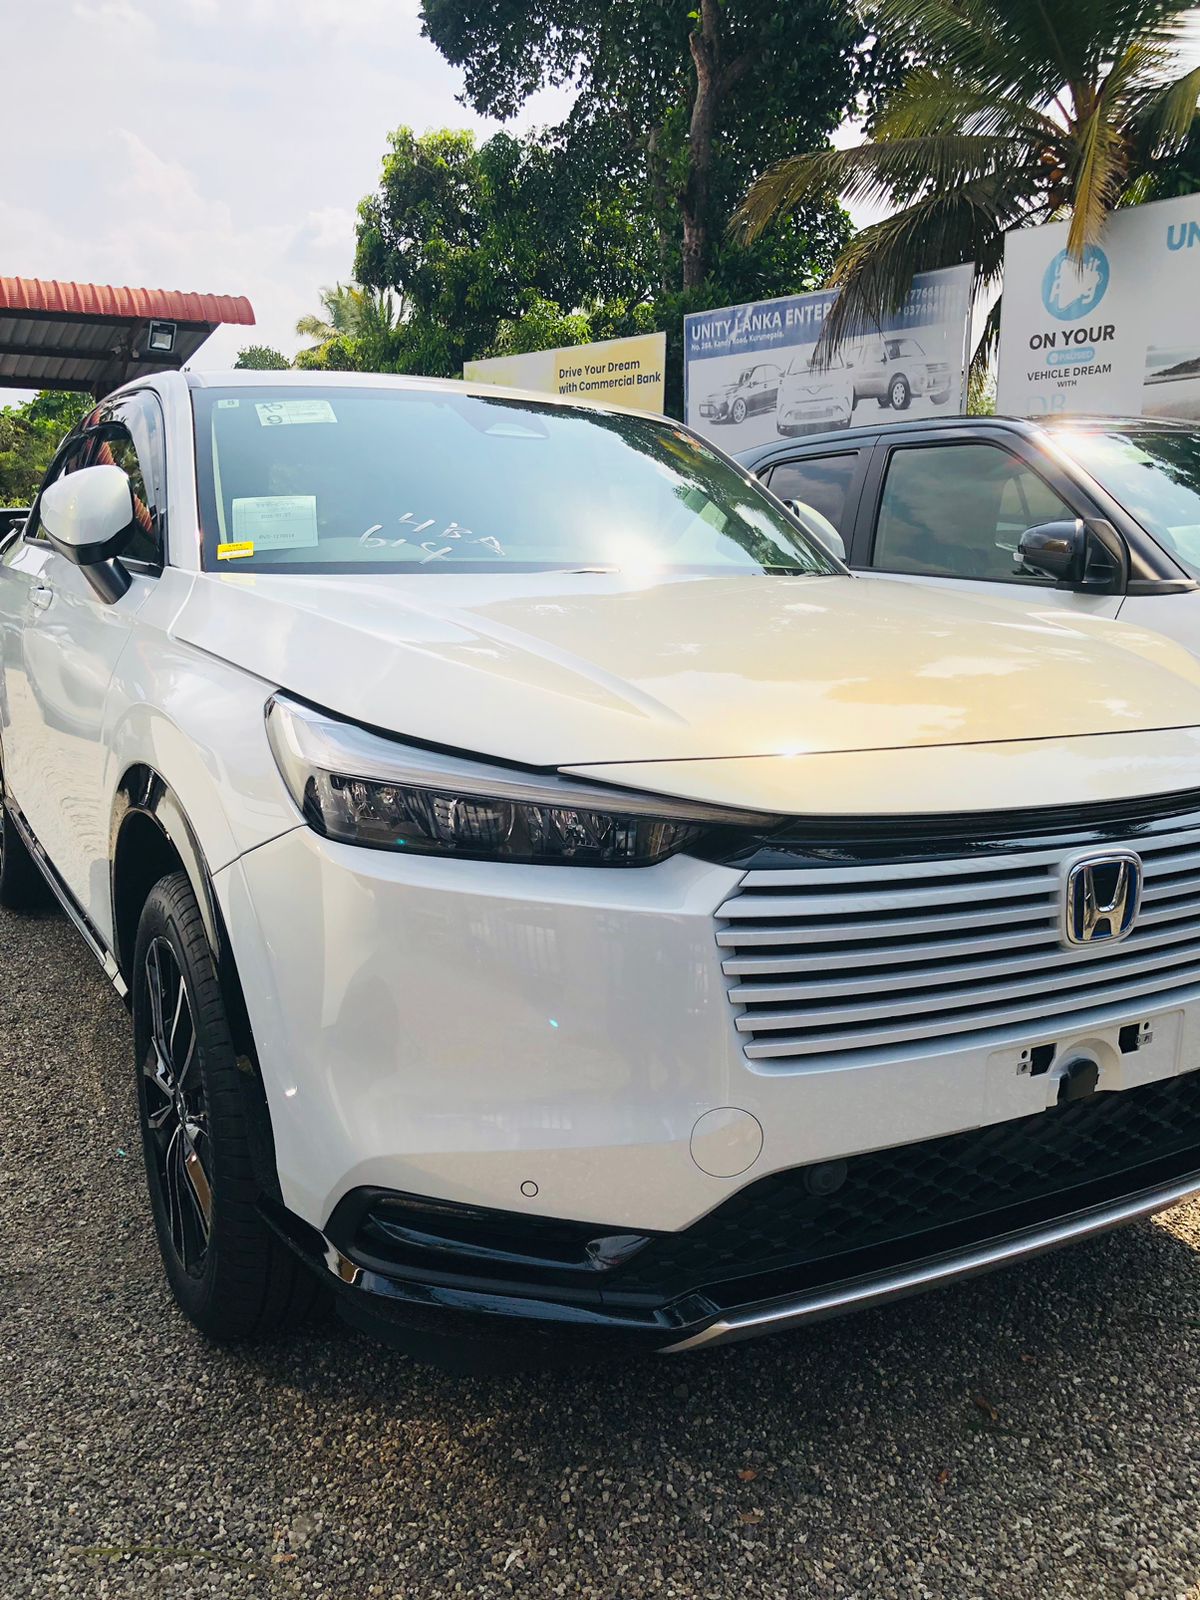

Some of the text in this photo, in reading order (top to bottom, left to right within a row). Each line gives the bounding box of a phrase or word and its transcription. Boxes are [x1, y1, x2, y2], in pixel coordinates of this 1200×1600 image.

[691, 302, 832, 340] UNITY LANKA ENTER
[1029, 324, 1115, 350] ON YOUR
[559, 360, 640, 379] Drive Your Dream
[1027, 363, 1112, 381] VEHICLE DREAM
[559, 371, 661, 395] with Commercial Bank
[1056, 380, 1077, 388] WITH
